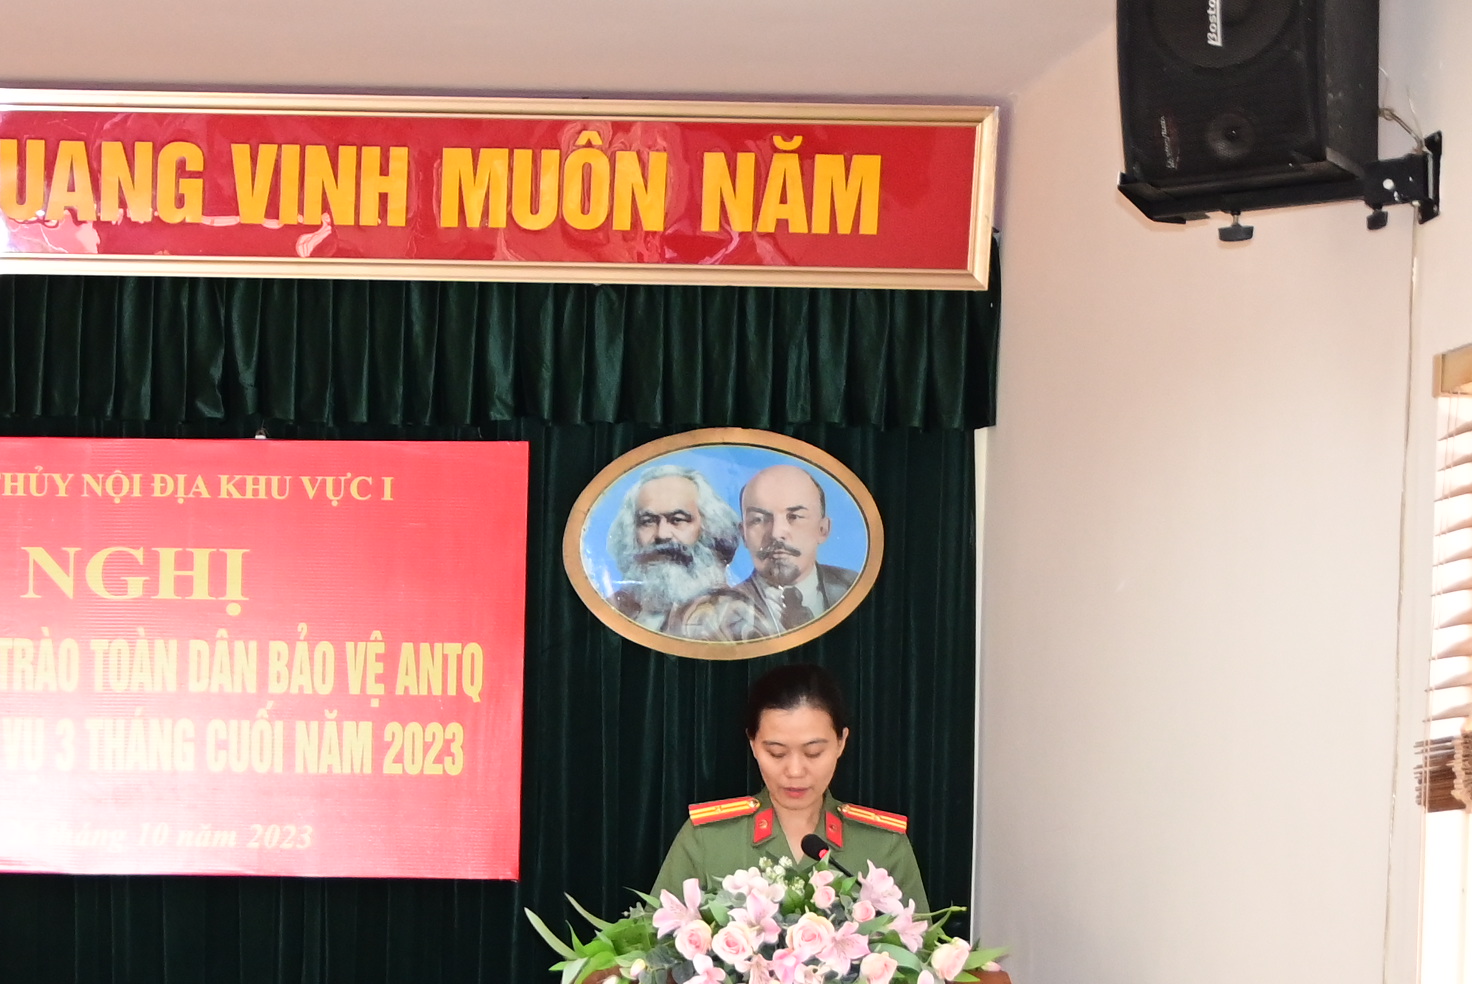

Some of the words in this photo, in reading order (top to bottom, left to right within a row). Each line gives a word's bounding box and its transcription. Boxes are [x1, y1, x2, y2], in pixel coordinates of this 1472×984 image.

[230, 143, 409, 227] VINH
[439, 130, 669, 231] MUÔN
[700, 135, 882, 235] NĂM
[81, 469, 143, 504] NỘI
[151, 473, 211, 504] ĐỊA
[218, 474, 292, 500] KHU
[300, 472, 372, 507] VỰC
[381, 476, 395, 500] I
[20, 546, 251, 616] NGHỊ
[90, 626, 178, 693] TOÀN
[188, 628, 258, 693] DÂN
[268, 622, 336, 695] BẢO
[345, 630, 386, 708] VỆ
[395, 642, 484, 703] ANTQ
[55, 718, 77, 771] 3
[85, 706, 195, 772] THÁNG
[206, 700, 284, 774] CUỐI
[294, 709, 373, 775] NĂM
[383, 721, 465, 776] 2023
[137, 822, 169, 847] 10
[175, 823, 238, 848] năm
[246, 823, 314, 850] 2023
